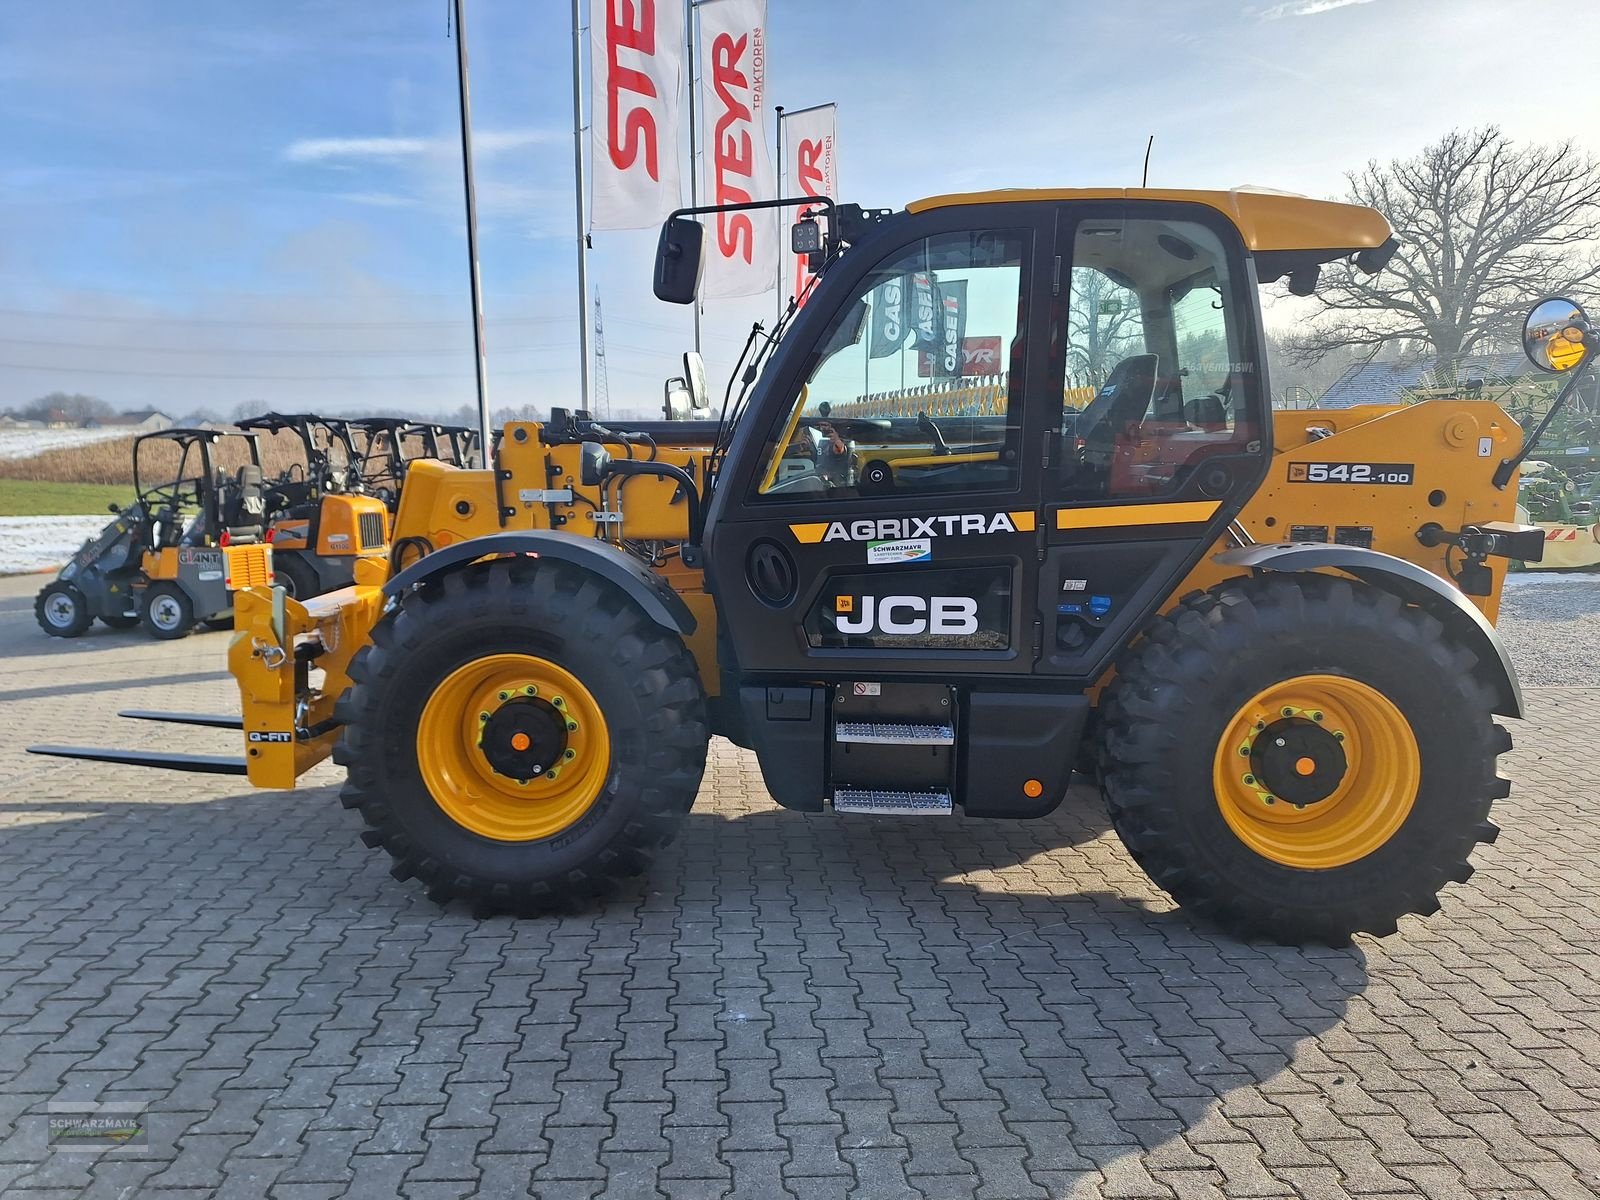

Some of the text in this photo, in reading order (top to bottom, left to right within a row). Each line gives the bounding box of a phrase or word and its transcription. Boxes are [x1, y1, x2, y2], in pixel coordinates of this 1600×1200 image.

[753, 27, 762, 110] TRAKTOREN
[711, 32, 753, 265] STEYR
[944, 315, 958, 371] CASE
[1308, 464, 1409, 483] 542-100
[824, 512, 1015, 542] AGRIXTRA
[179, 549, 220, 565] GIANT
[873, 544, 921, 552] SCHWARZMAYR
[836, 595, 978, 634] JCB
[249, 732, 290, 741] Q-FIT
